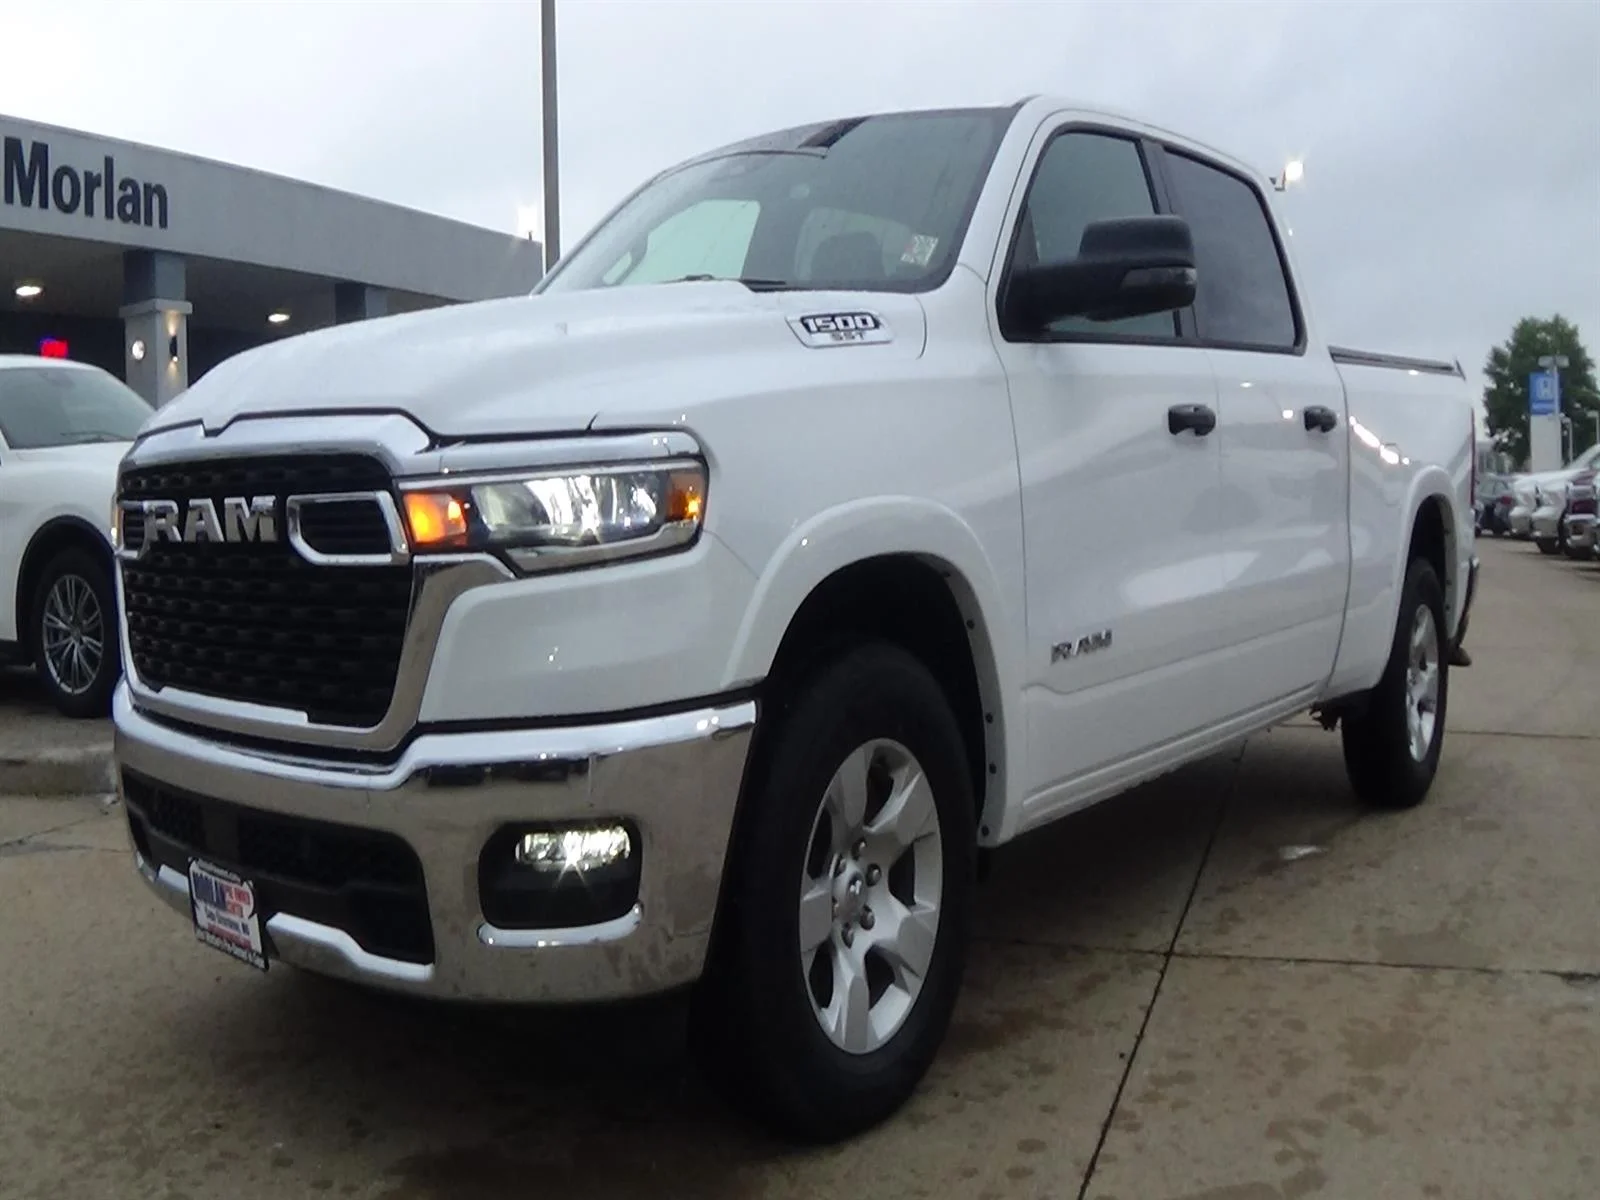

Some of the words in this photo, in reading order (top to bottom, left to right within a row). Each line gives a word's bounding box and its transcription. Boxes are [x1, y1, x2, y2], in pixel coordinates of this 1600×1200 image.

[4, 136, 168, 229] Morlan
[801, 313, 879, 334] 1500
[143, 495, 277, 542] RAM
[1050, 628, 1113, 665] RAM
